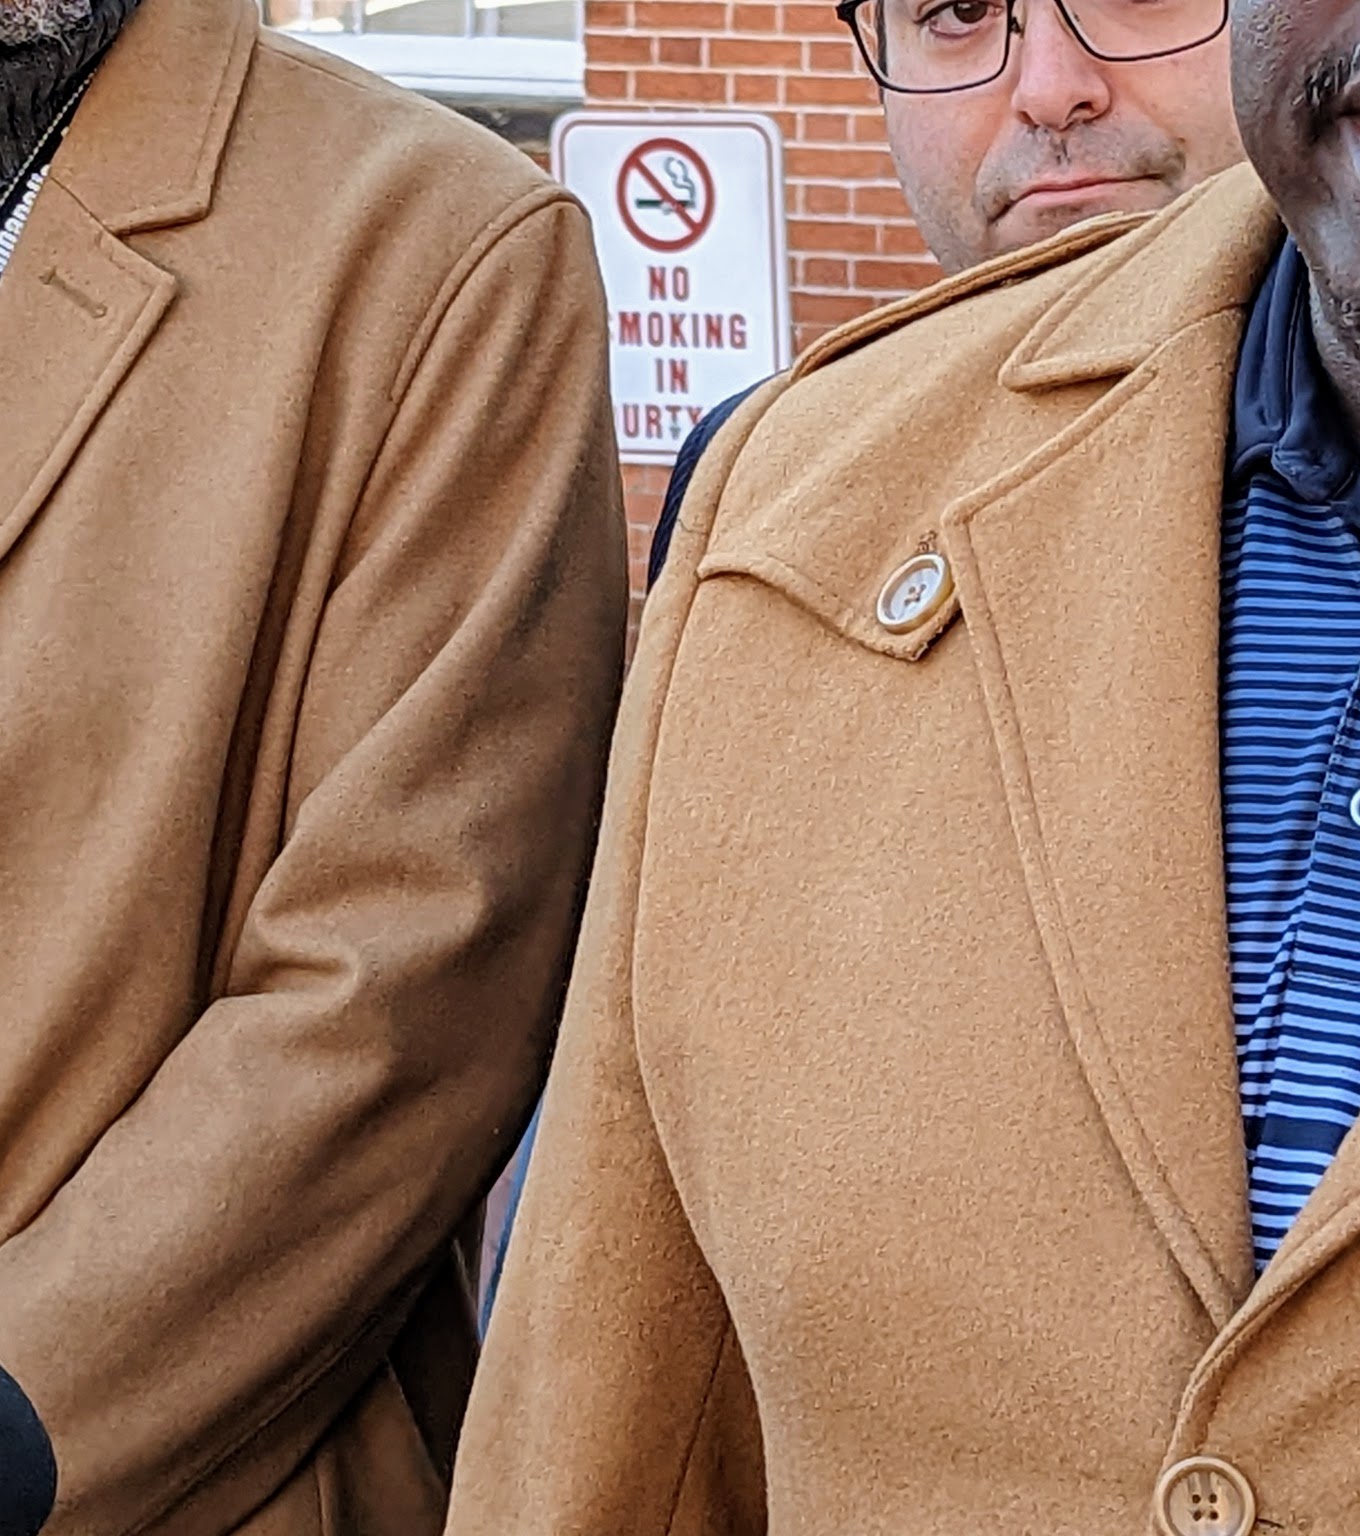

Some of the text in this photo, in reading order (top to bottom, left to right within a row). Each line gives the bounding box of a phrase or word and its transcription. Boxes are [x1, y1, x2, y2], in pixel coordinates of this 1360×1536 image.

[648, 266, 690, 301] NO
[609, 311, 748, 350] MOKING
[654, 357, 690, 395] IN
